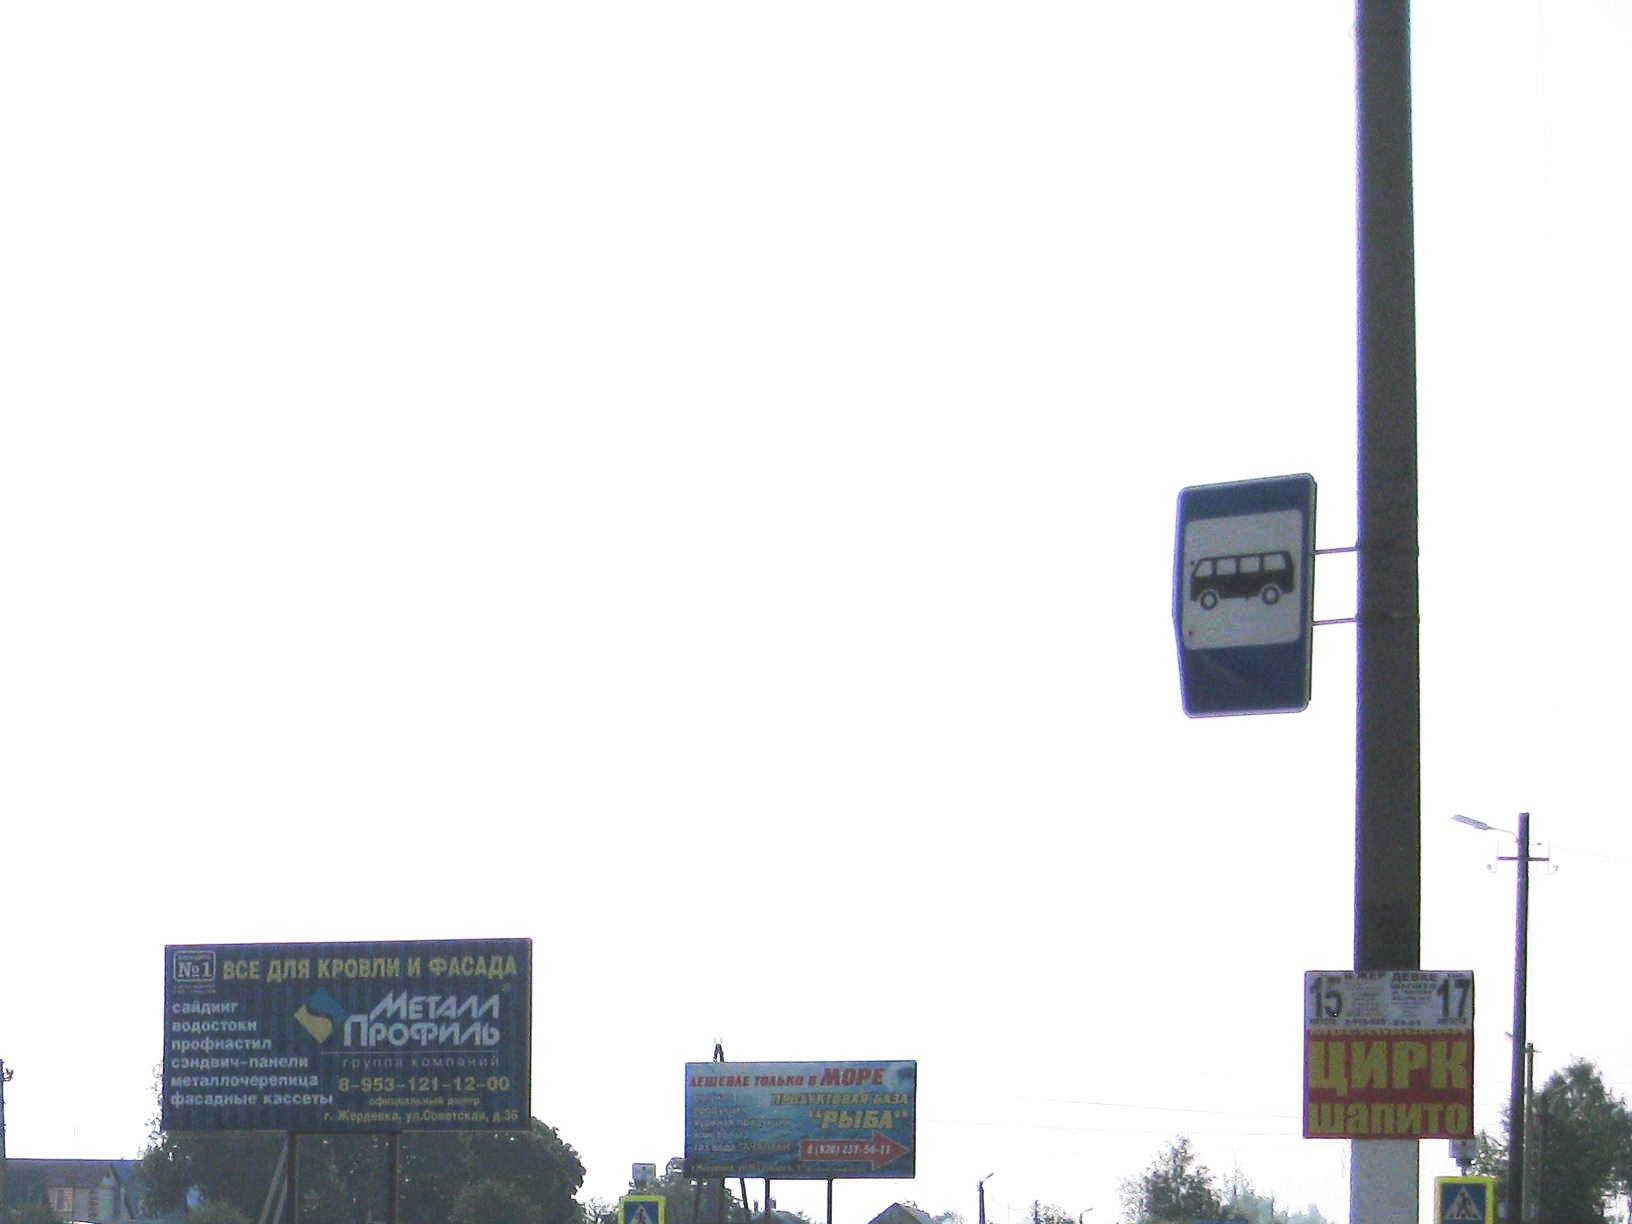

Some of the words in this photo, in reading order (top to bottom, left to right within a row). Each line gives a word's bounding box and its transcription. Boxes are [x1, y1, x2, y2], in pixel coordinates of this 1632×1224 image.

[223, 960, 260, 980] ВСЕ
[267, 959, 310, 983] ДЛЯ
[318, 957, 400, 979] КРОВЛИ
[408, 957, 422, 977] И
[428, 954, 518, 979] ФАСАДА
[1309, 976, 1344, 1018] 15
[1437, 978, 1470, 1018] 17
[171, 1000, 239, 1015] сайдинг
[171, 1020, 257, 1033] водостоки
[171, 1036, 272, 1053] профнастил
[170, 1057, 309, 1070] сэндвич-панели
[342, 1056, 403, 1071] группа
[411, 1055, 500, 1068] компаний
[1310, 1040, 1469, 1097] ЦИРК
[170, 1074, 319, 1088] металлочерепица
[820, 1067, 886, 1087] МОРЕ
[170, 1091, 257, 1107] фасадные
[263, 1093, 334, 1105] кассеты
